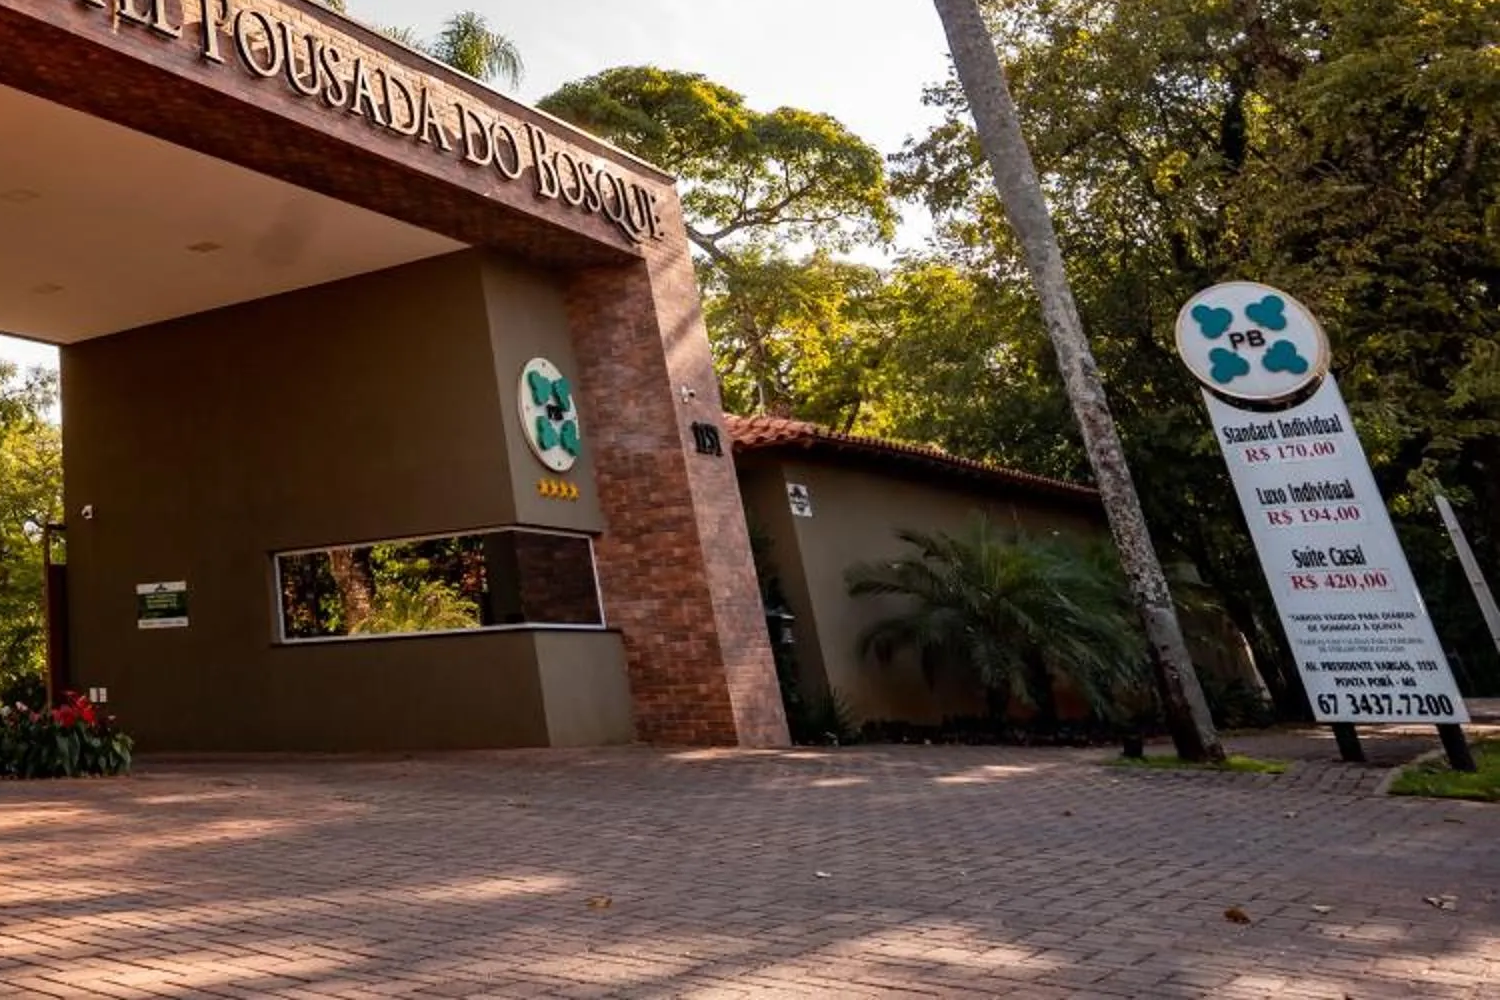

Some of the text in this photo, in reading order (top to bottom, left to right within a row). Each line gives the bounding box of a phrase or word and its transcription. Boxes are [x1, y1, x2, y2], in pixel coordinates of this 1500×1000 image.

[455, 102, 524, 181] DO
[1228, 329, 1267, 349] PB
[1222, 413, 1344, 444] Standard Individual
[1245, 447, 1271, 462] R$
[1256, 478, 1355, 505] Luxo Individual
[1267, 505, 1360, 525] R$ 194,00
[1328, 544, 1367, 567] Casal
[1291, 571, 1388, 591] R$ 420,00
[1320, 661, 1373, 671] PRESIDENTE
[1334, 676, 1366, 687] PONTA
[1317, 693, 1455, 717] 67 3437.7200
